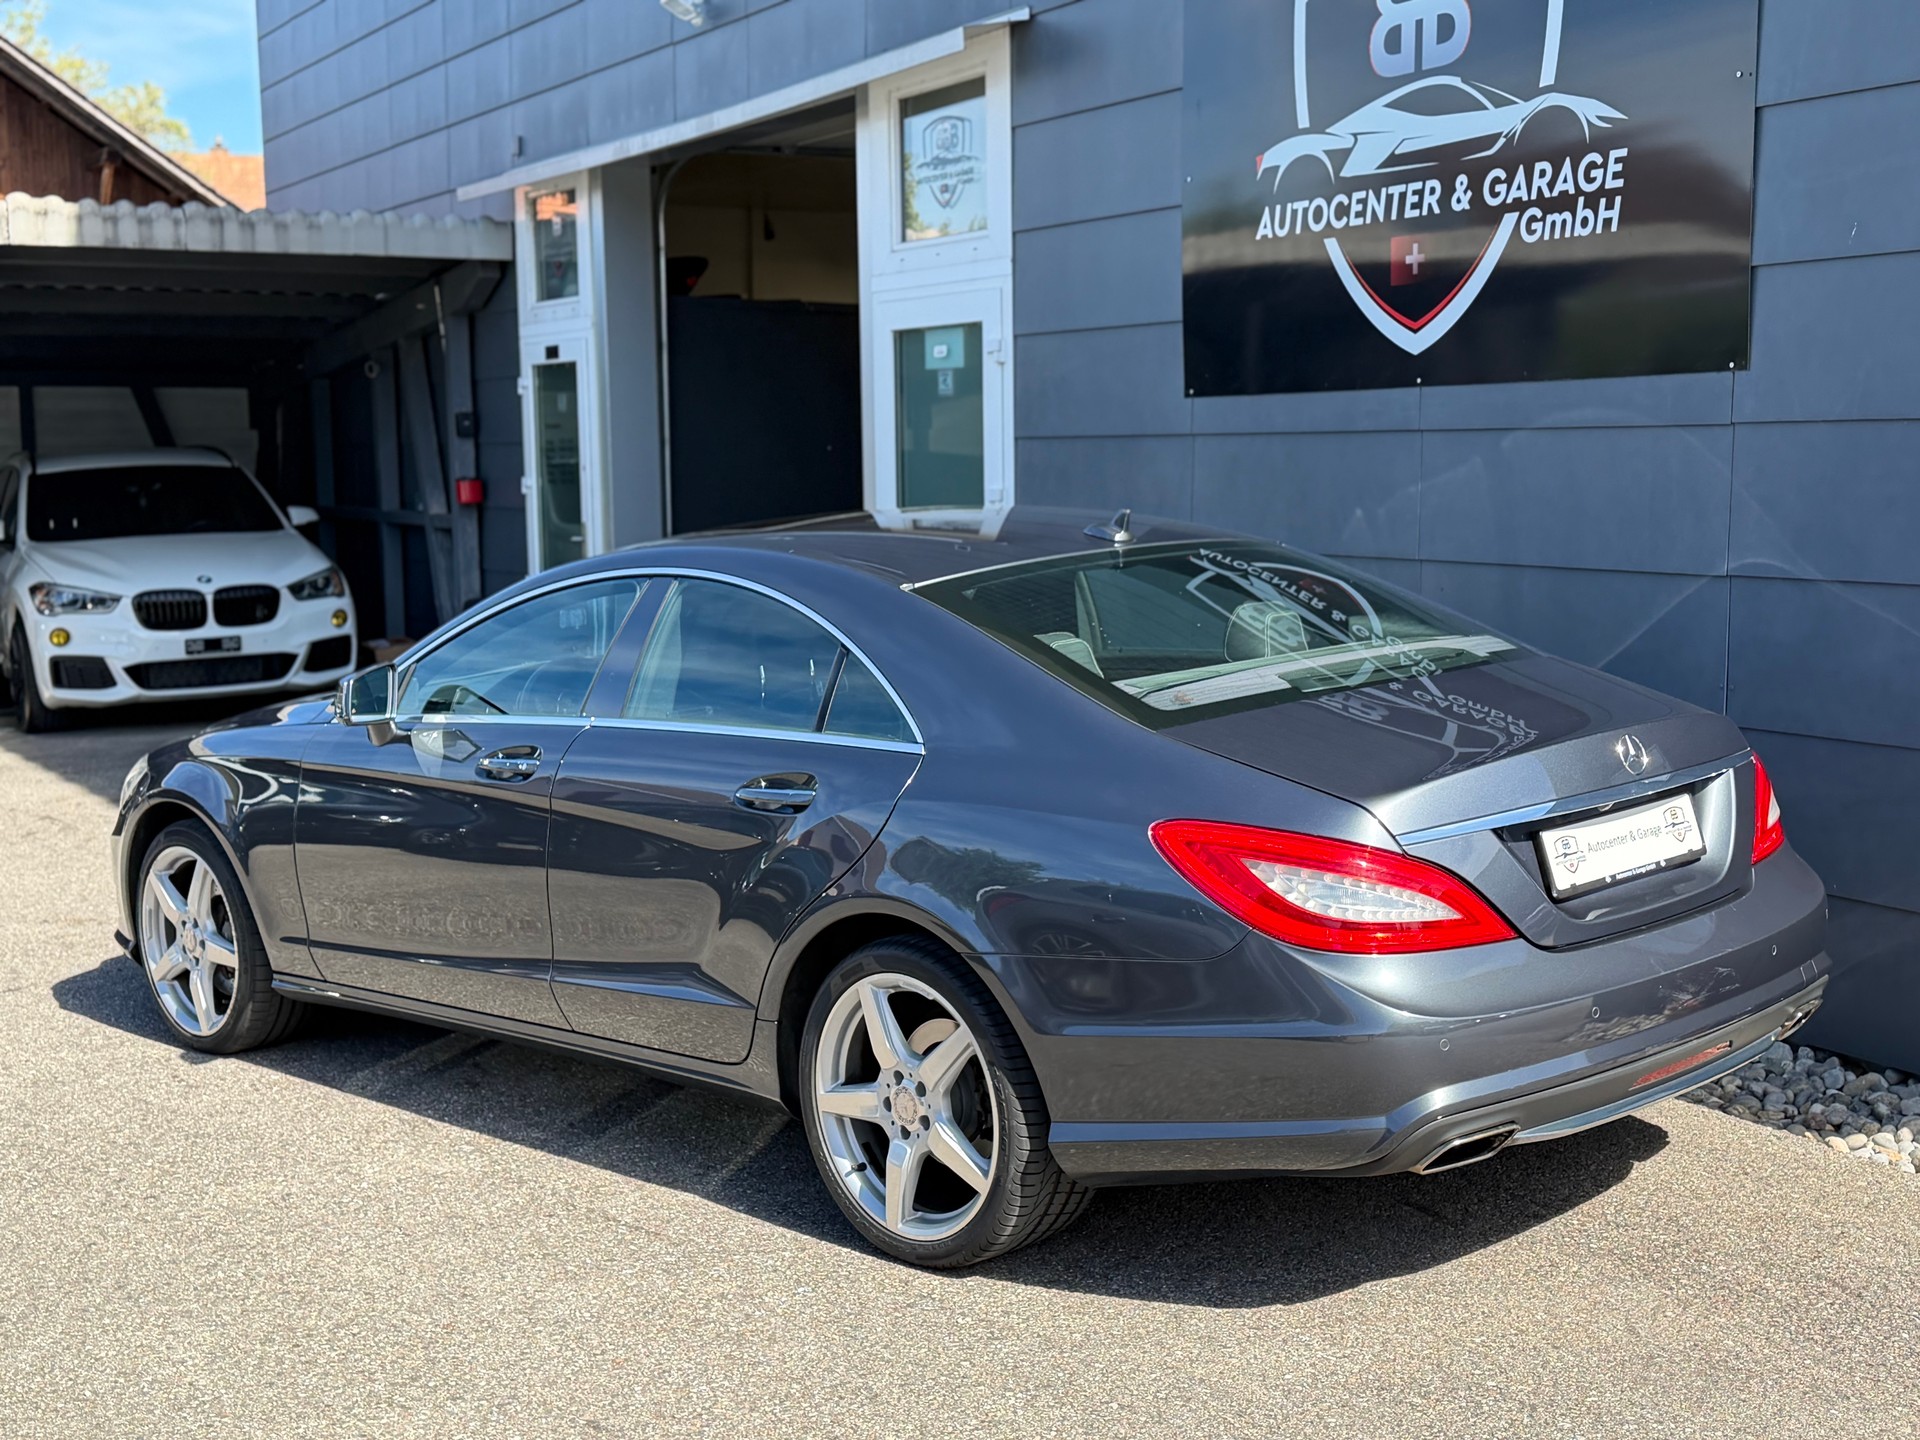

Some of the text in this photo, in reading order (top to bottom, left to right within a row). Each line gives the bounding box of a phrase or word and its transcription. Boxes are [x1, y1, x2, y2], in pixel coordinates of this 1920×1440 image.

[1256, 147, 1629, 240] AUTOCENTER & GARAGE
[1520, 196, 1622, 244] GmbH
[1587, 834, 1628, 853] Autocenter
[1629, 830, 1637, 842] &
[1637, 826, 1662, 841] Garage
